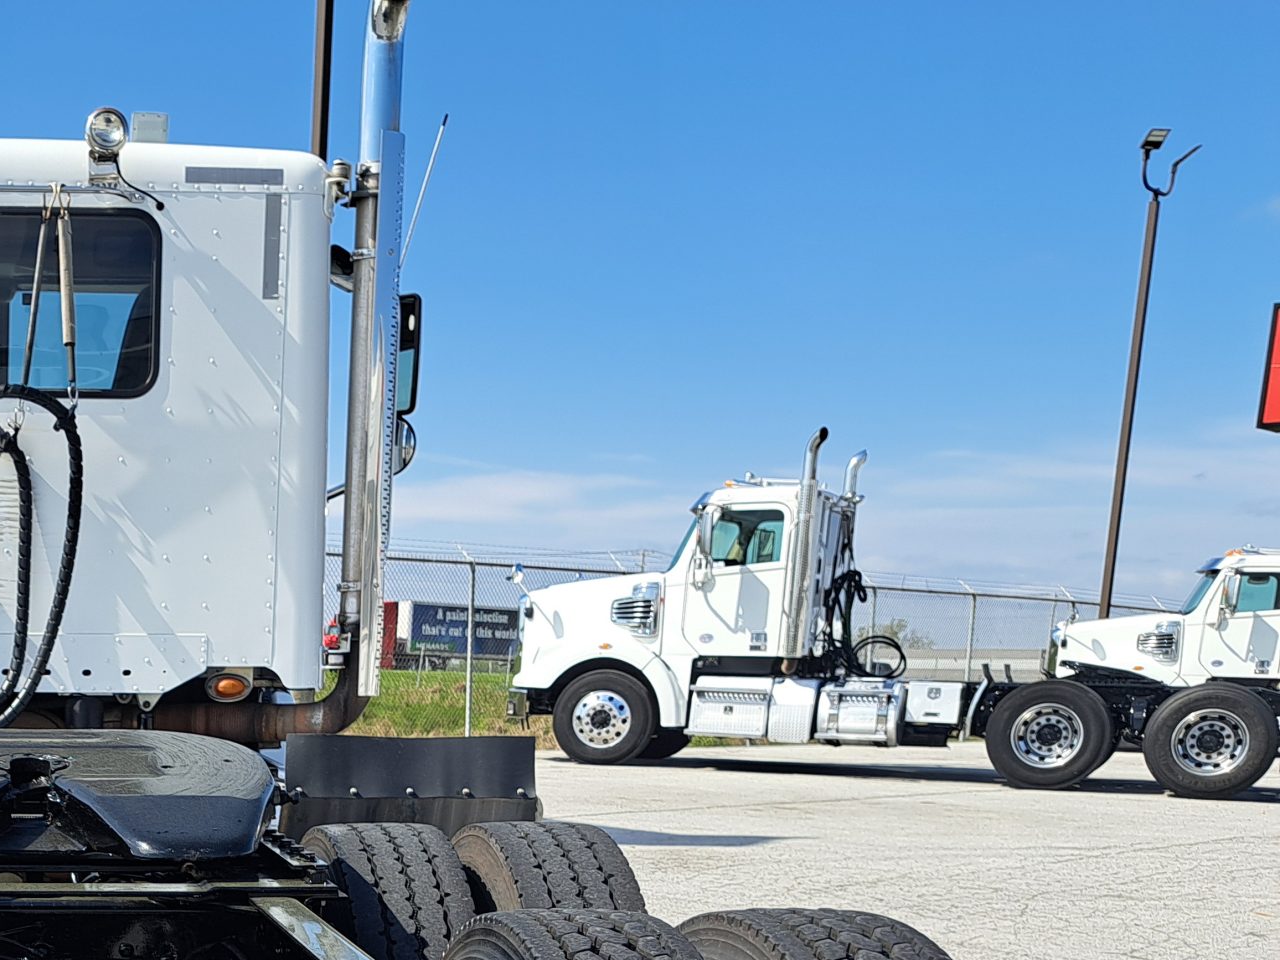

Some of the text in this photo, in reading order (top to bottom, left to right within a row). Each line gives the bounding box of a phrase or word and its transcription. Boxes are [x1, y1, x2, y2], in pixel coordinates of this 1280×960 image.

[437, 608, 509, 624] A paint election
[421, 622, 447, 636] that's
[475, 625, 493, 639] this
